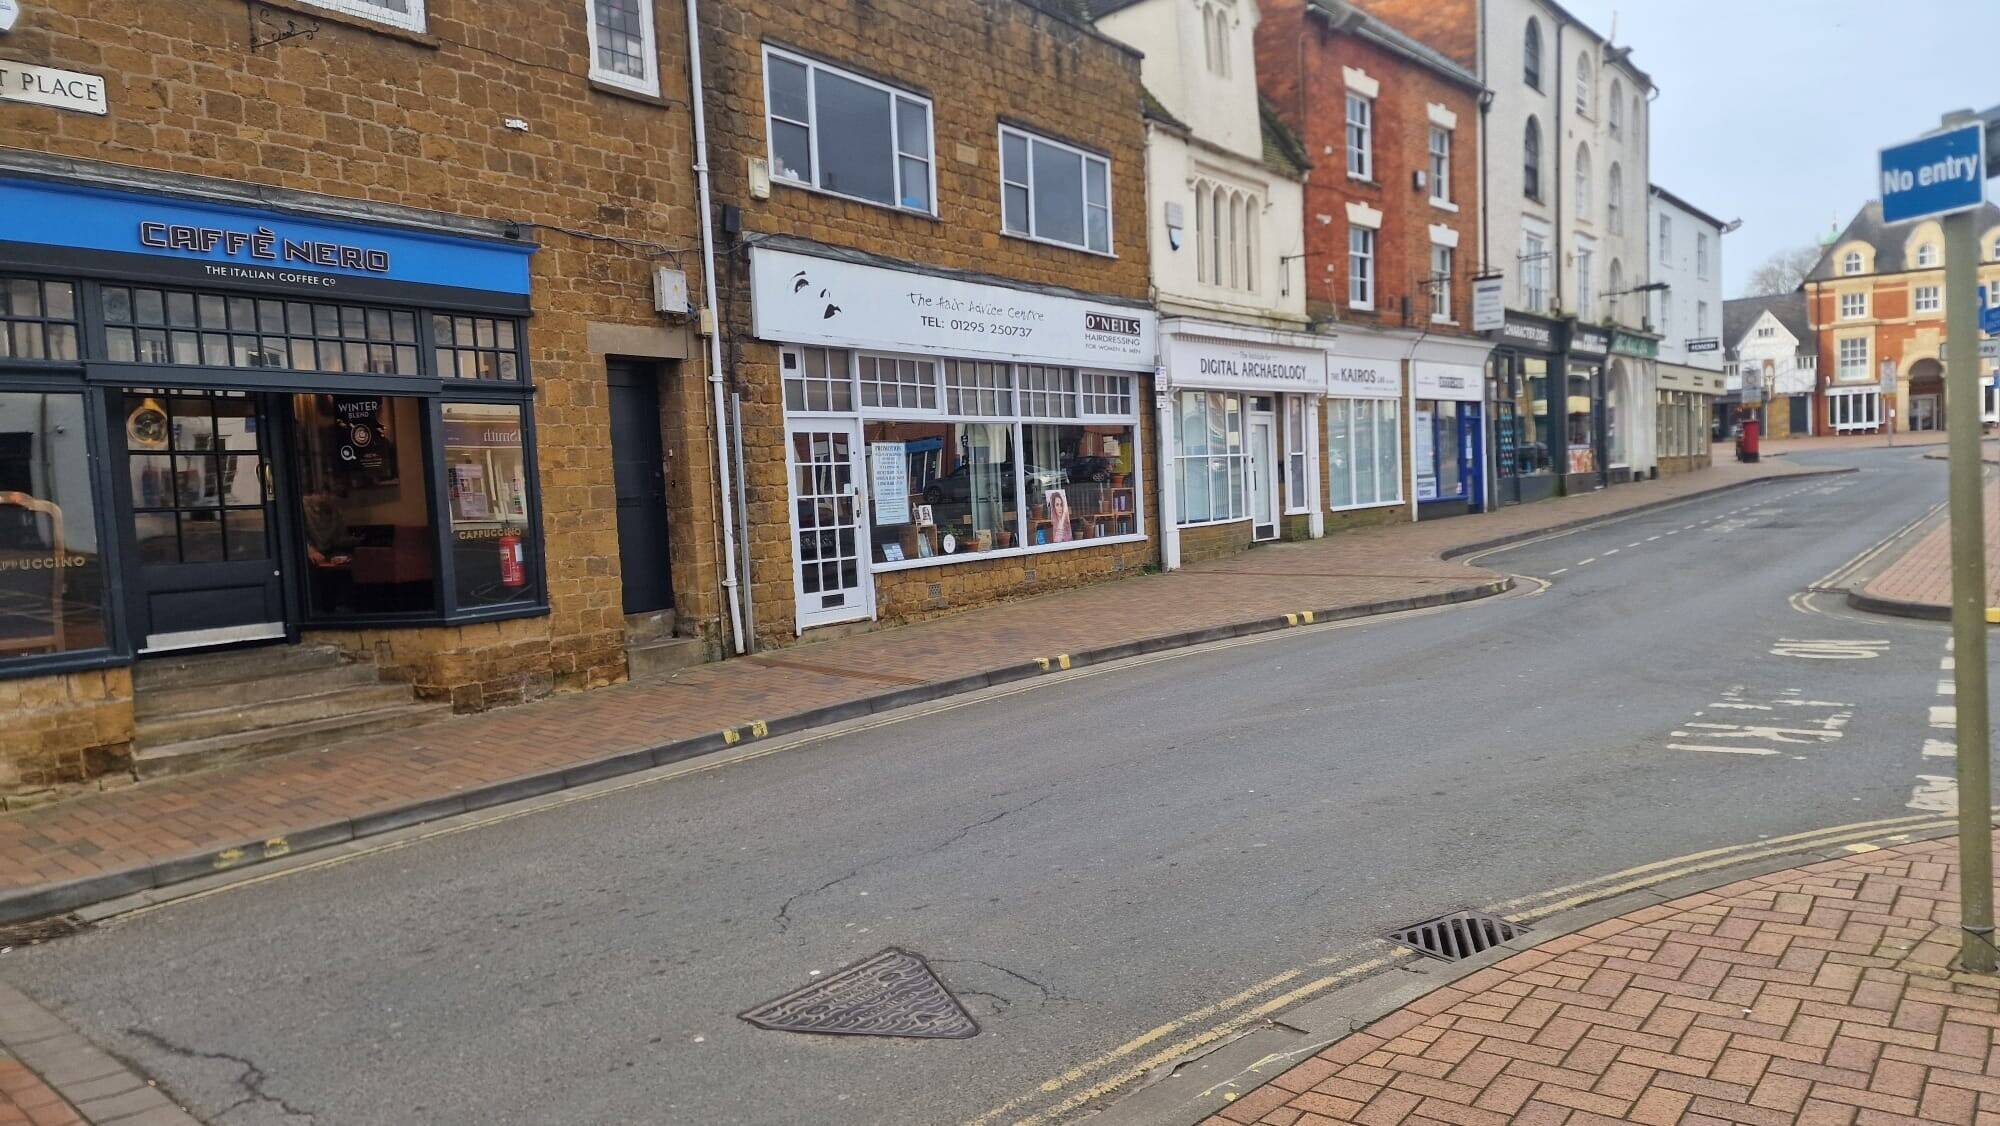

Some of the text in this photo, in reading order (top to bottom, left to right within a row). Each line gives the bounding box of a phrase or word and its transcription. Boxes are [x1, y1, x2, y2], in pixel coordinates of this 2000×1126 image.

[20, 71, 98, 102] PLACE
[1883, 154, 1978, 195] No entry
[139, 220, 390, 273] CAFFÈ NERO
[205, 265, 227, 276] THE
[230, 268, 275, 281] ITALIAN
[279, 272, 319, 286] COFFEE
[906, 292, 932, 307] The
[1007, 307, 1046, 322] Centre
[921, 315, 1033, 338] TEL: 01295 250737
[1086, 315, 1140, 335] O'NEILS
[1085, 334, 1140, 346] HAIRDRESSING
[1200, 358, 1307, 380] DIGITAL ARCHAEOLOGY
[1341, 367, 1376, 384] KAIROS
[337, 401, 378, 412] WINTER
[459, 527, 522, 540] CAPPUCCINO
